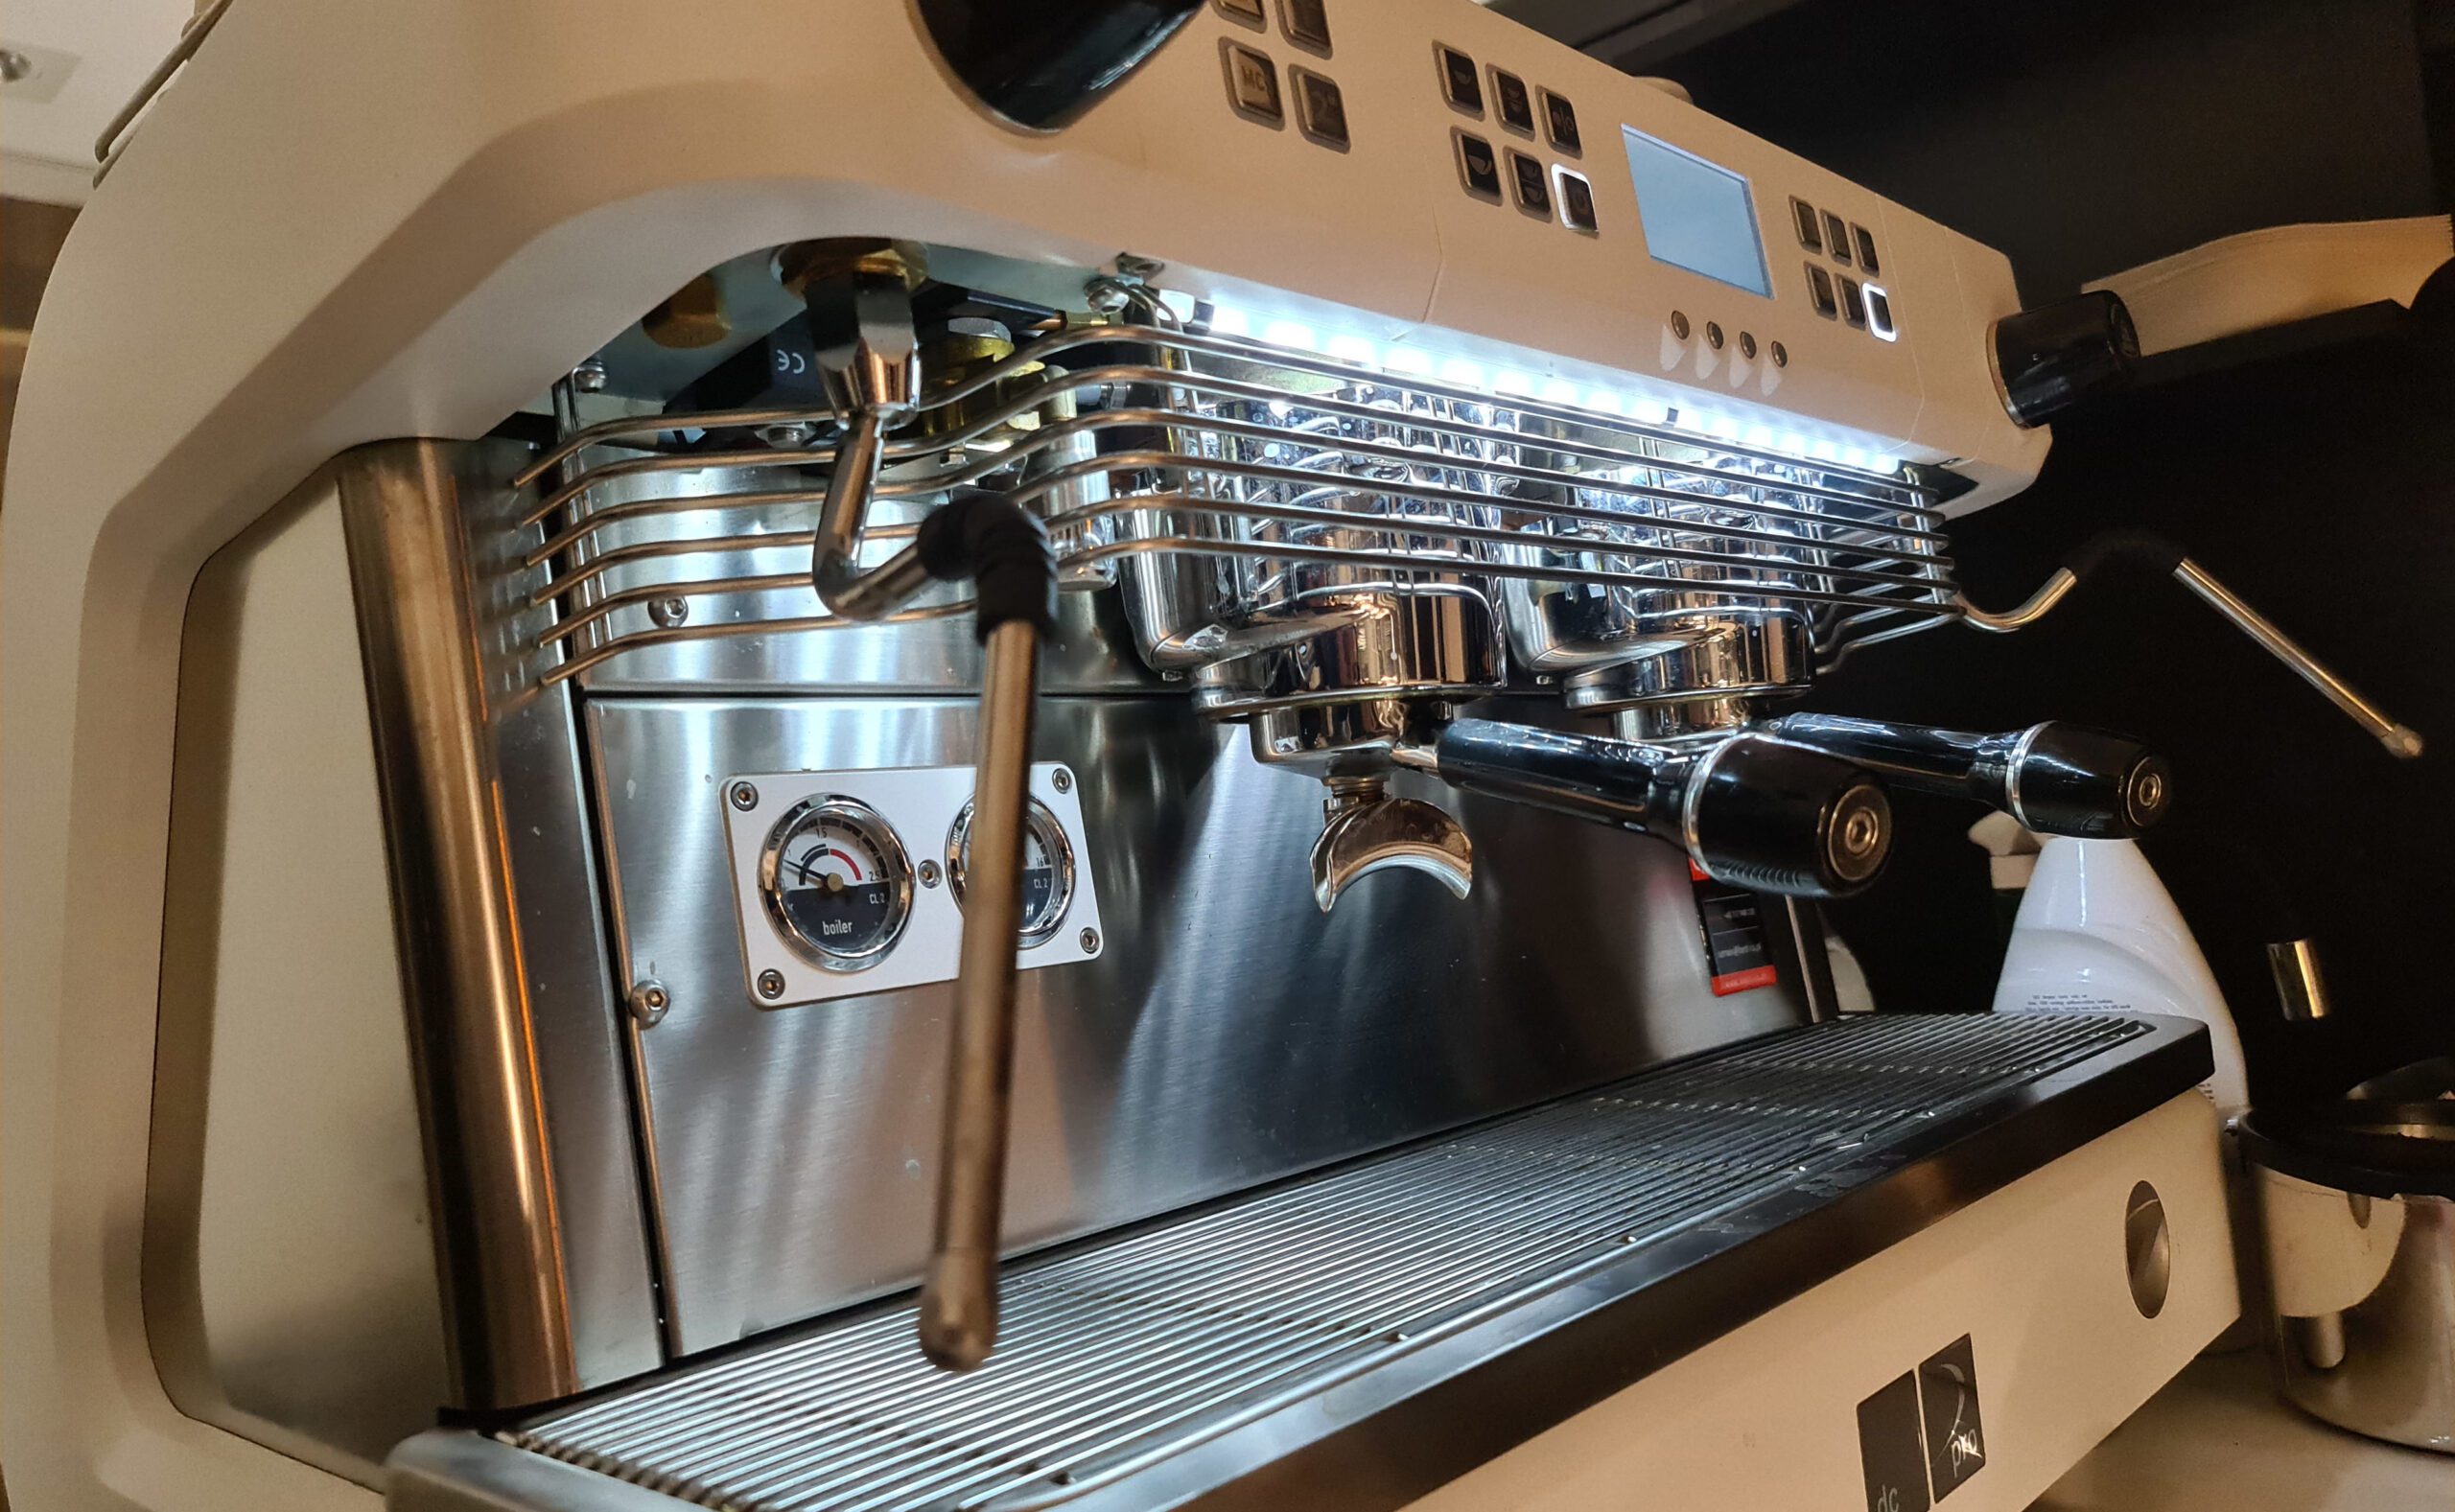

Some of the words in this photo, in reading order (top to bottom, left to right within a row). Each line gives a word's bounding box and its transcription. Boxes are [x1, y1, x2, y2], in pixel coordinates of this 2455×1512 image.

[777, 349, 806, 374] CE
[816, 826, 828, 839] 1.5
[822, 919, 853, 936] boiler
